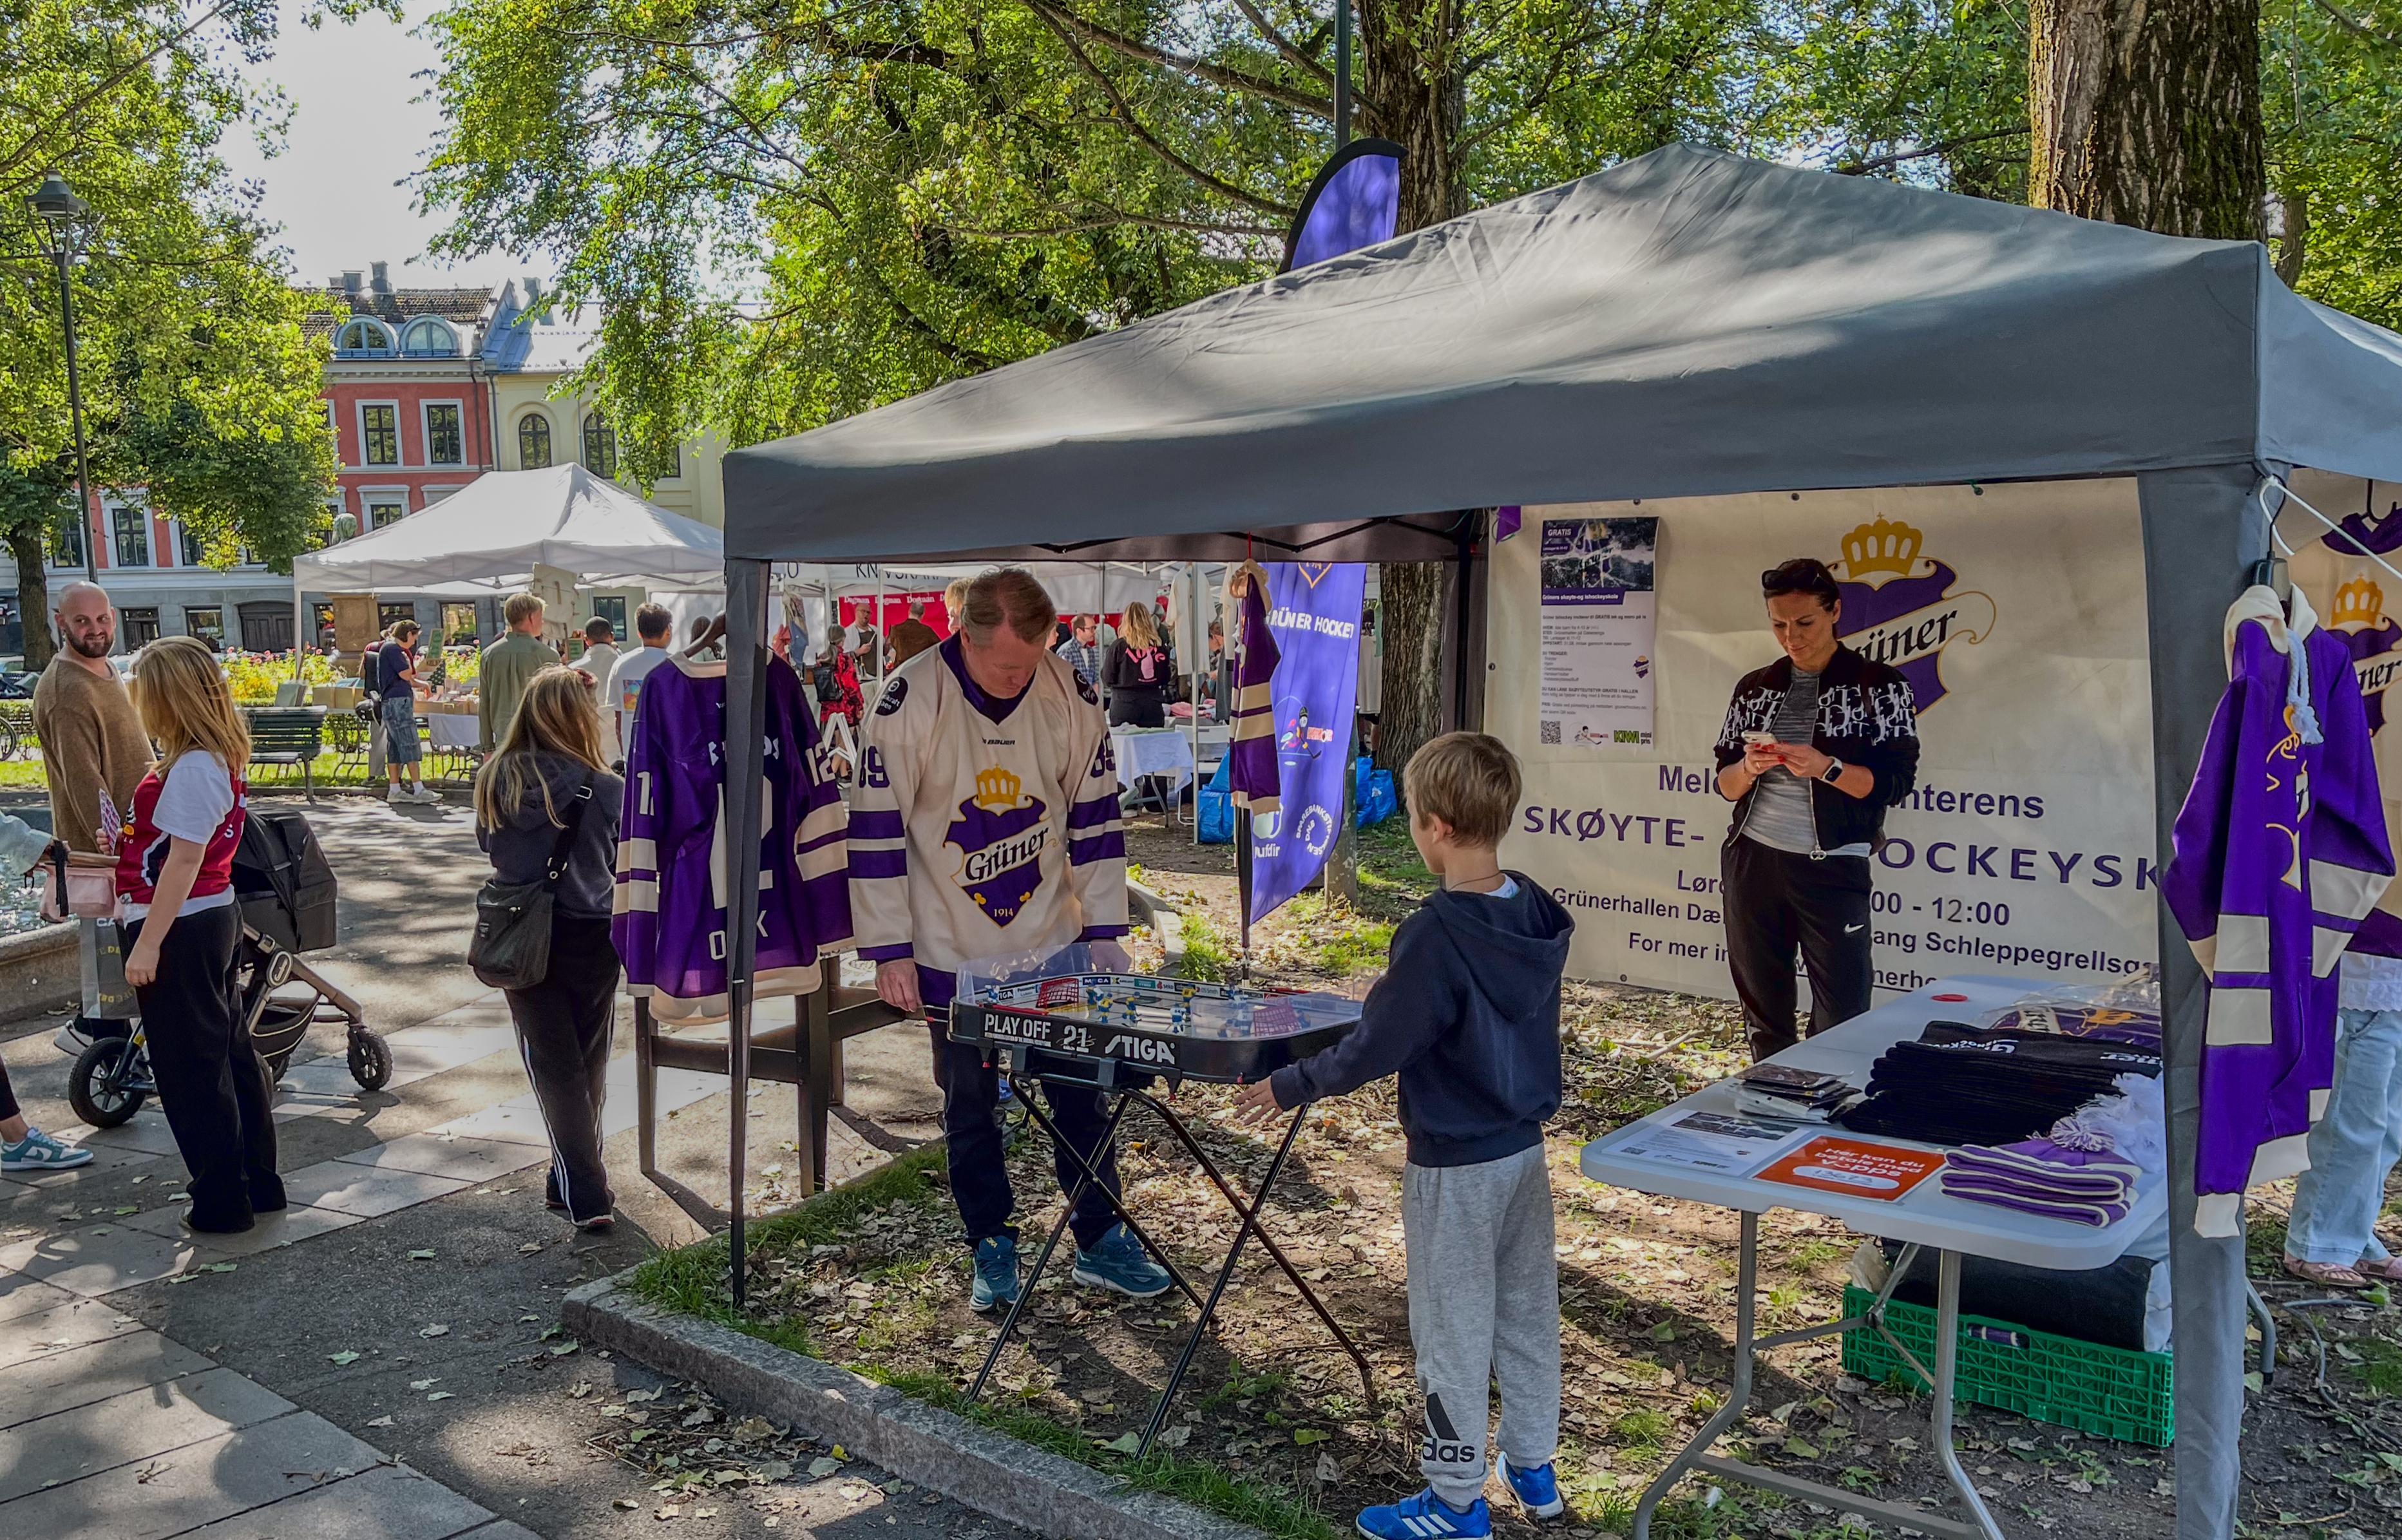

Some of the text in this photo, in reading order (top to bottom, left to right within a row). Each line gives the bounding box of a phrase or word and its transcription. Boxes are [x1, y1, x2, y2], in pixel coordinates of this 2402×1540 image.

[1855, 610, 1958, 663] üner
[1614, 730, 1640, 744] KIWI
[805, 741, 836, 787] 12
[1523, 806, 1704, 848] SKØYTE-
[965, 826, 1050, 883] Grüner
[994, 908, 1014, 917] 1914
[1552, 888, 1679, 919] Grünerhallen
[1932, 897, 2010, 926] 12:00
[1629, 932, 1663, 953] For
[1668, 942, 1708, 959] mer
[1000, 991, 1013, 1000] IGA
[984, 1013, 1020, 1035] PLAY
[1022, 1018, 1051, 1040] OFF
[1063, 1025, 1089, 1053] 21
[1105, 1034, 1176, 1065] STIGA
[1815, 1152, 1924, 1174] betale med
[1825, 1148, 1926, 1168] Her kan du
[986, 1237, 998, 1248] OKA
[1422, 1438, 1475, 1463] das
